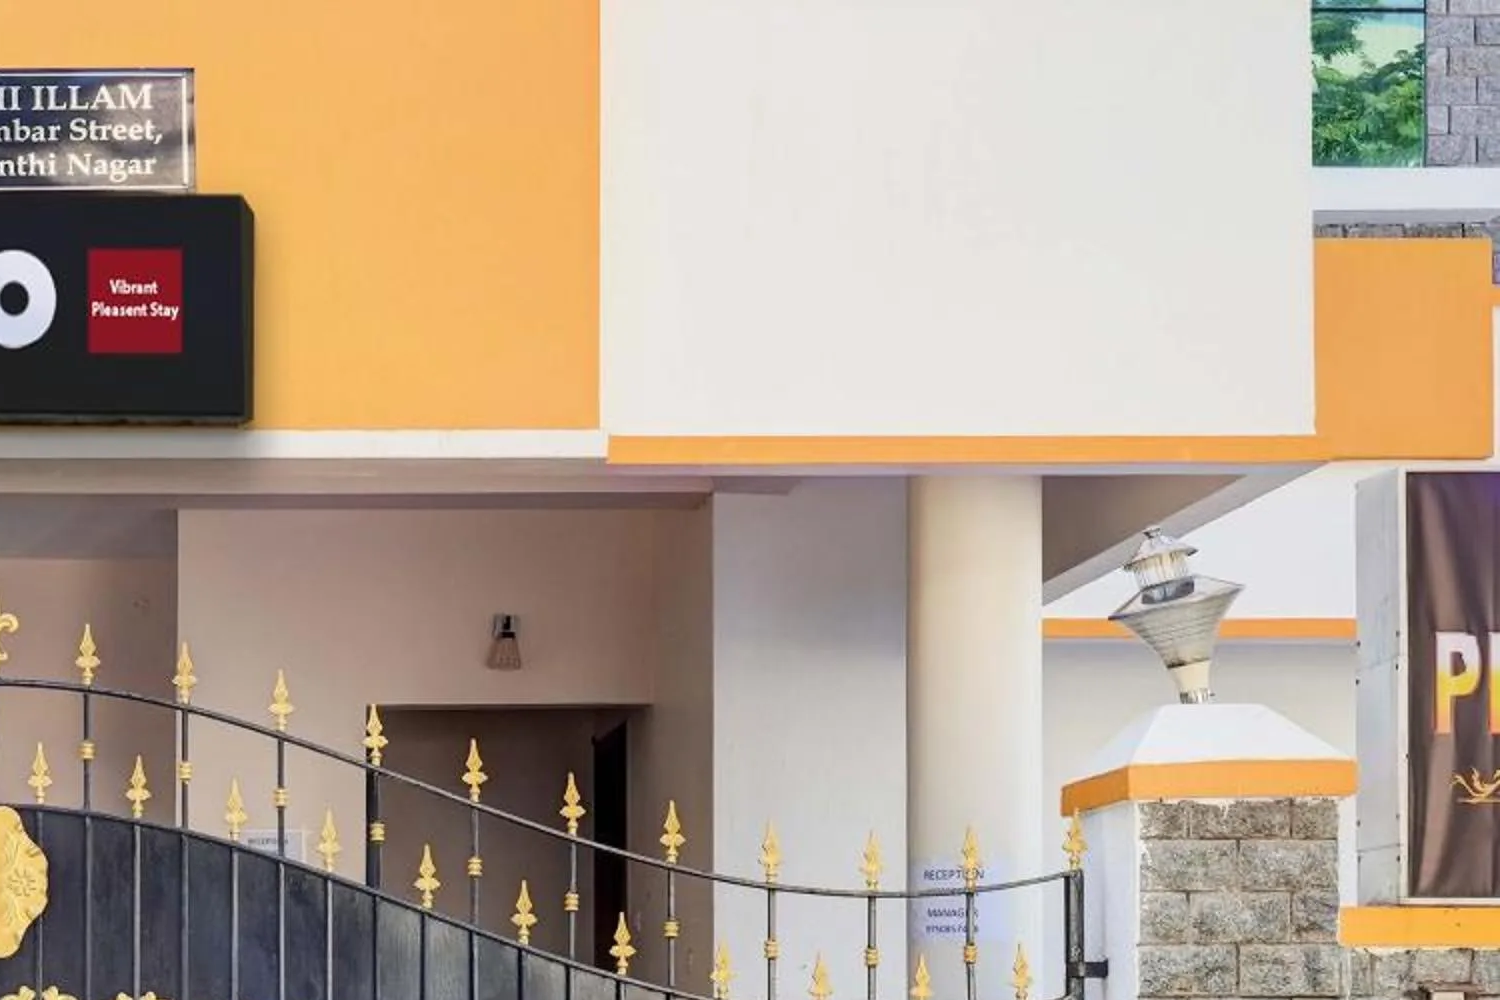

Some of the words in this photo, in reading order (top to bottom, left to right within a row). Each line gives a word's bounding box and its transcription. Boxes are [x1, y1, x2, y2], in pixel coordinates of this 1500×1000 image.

[31, 84, 153, 111] ILLAM
[69, 118, 164, 145] Street,
[66, 152, 157, 183] Nagar
[109, 278, 159, 295] Vibrant
[91, 301, 148, 317] Pleasent
[150, 301, 180, 321] Stay
